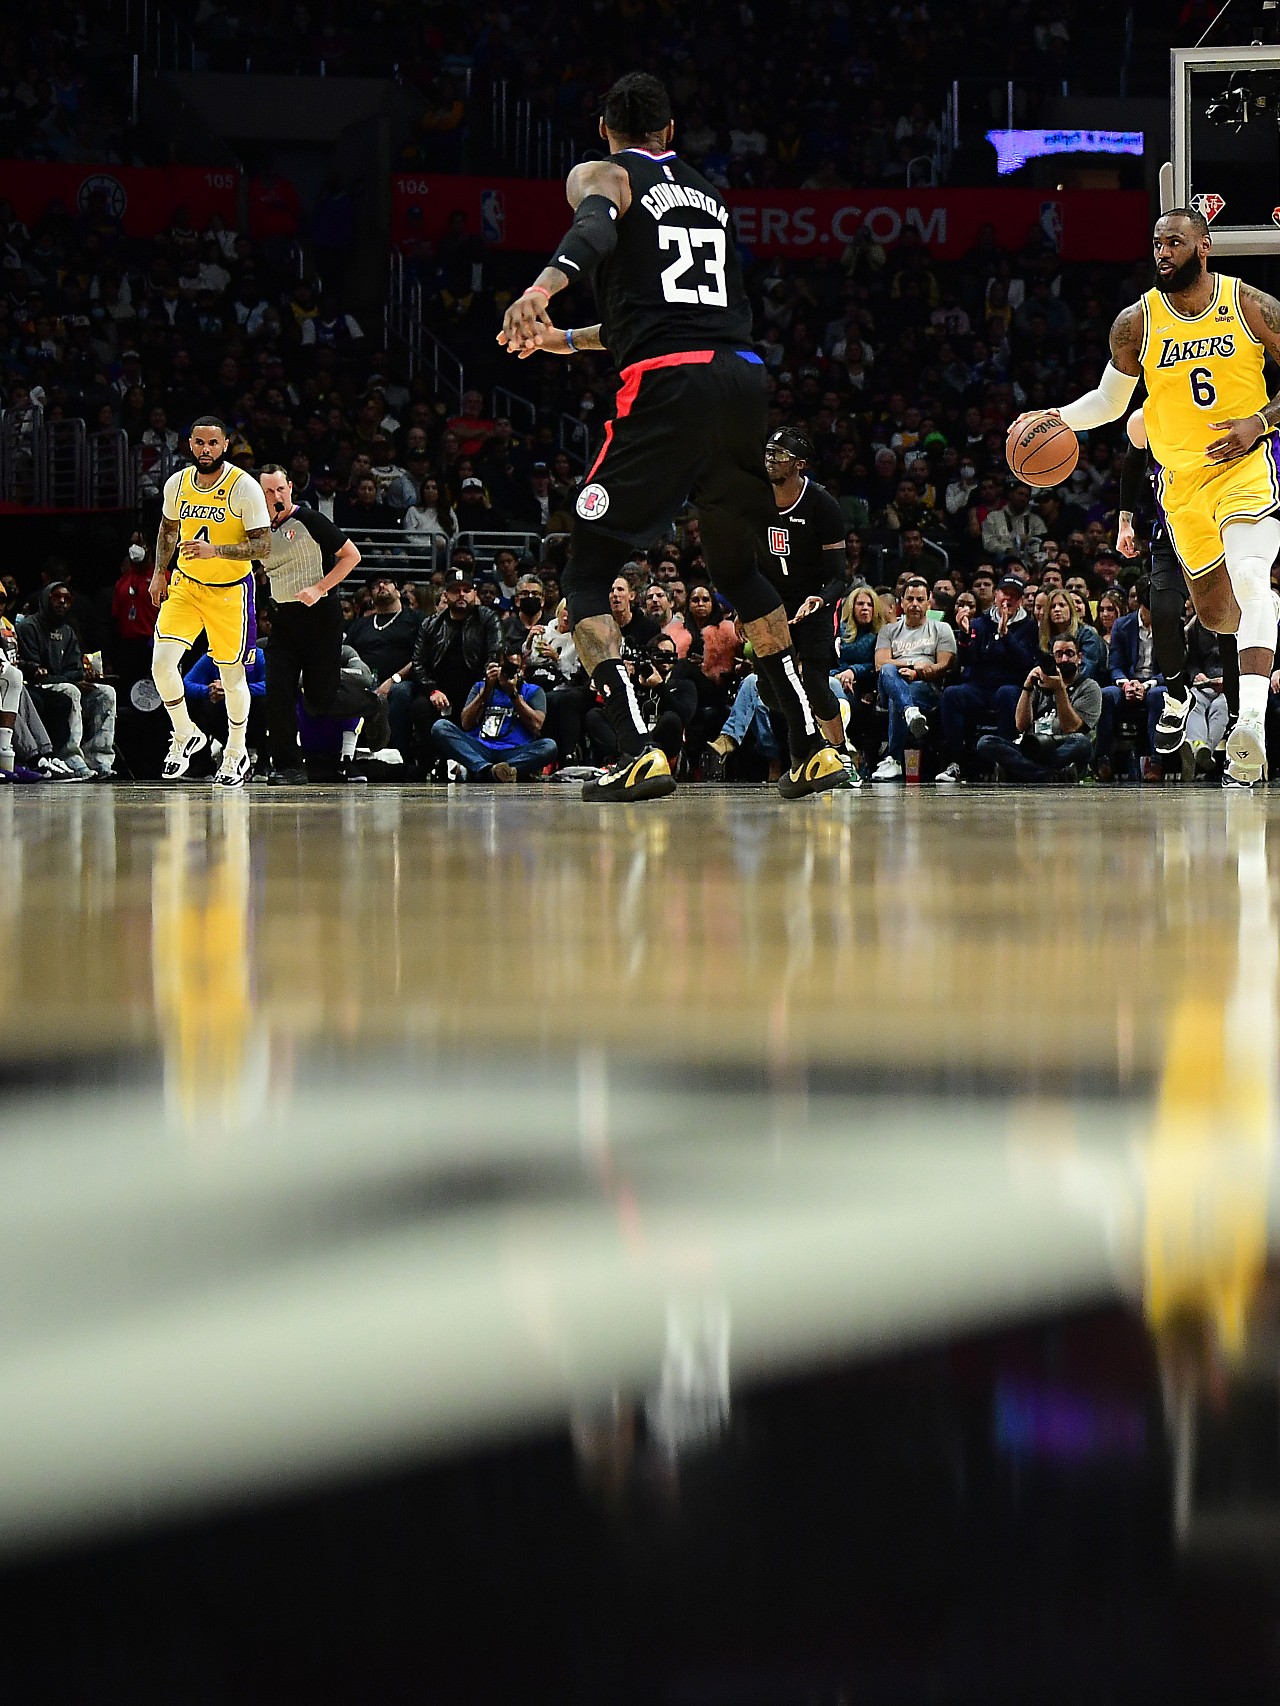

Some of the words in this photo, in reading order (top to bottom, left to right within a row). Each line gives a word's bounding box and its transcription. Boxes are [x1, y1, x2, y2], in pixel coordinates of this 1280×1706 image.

[204, 173, 235, 190] 105
[396, 179, 430, 196] 106
[640, 182, 730, 229] COVINGTON
[731, 205, 948, 245] ERS.COM
[657, 224, 729, 308] 23
[1214, 315, 1235, 323] bibigo
[1156, 334, 1236, 369] LAKERS
[1189, 366, 1217, 410] 6
[1020, 418, 1063, 448] Wilson
[179, 500, 226, 523] LAKERS
